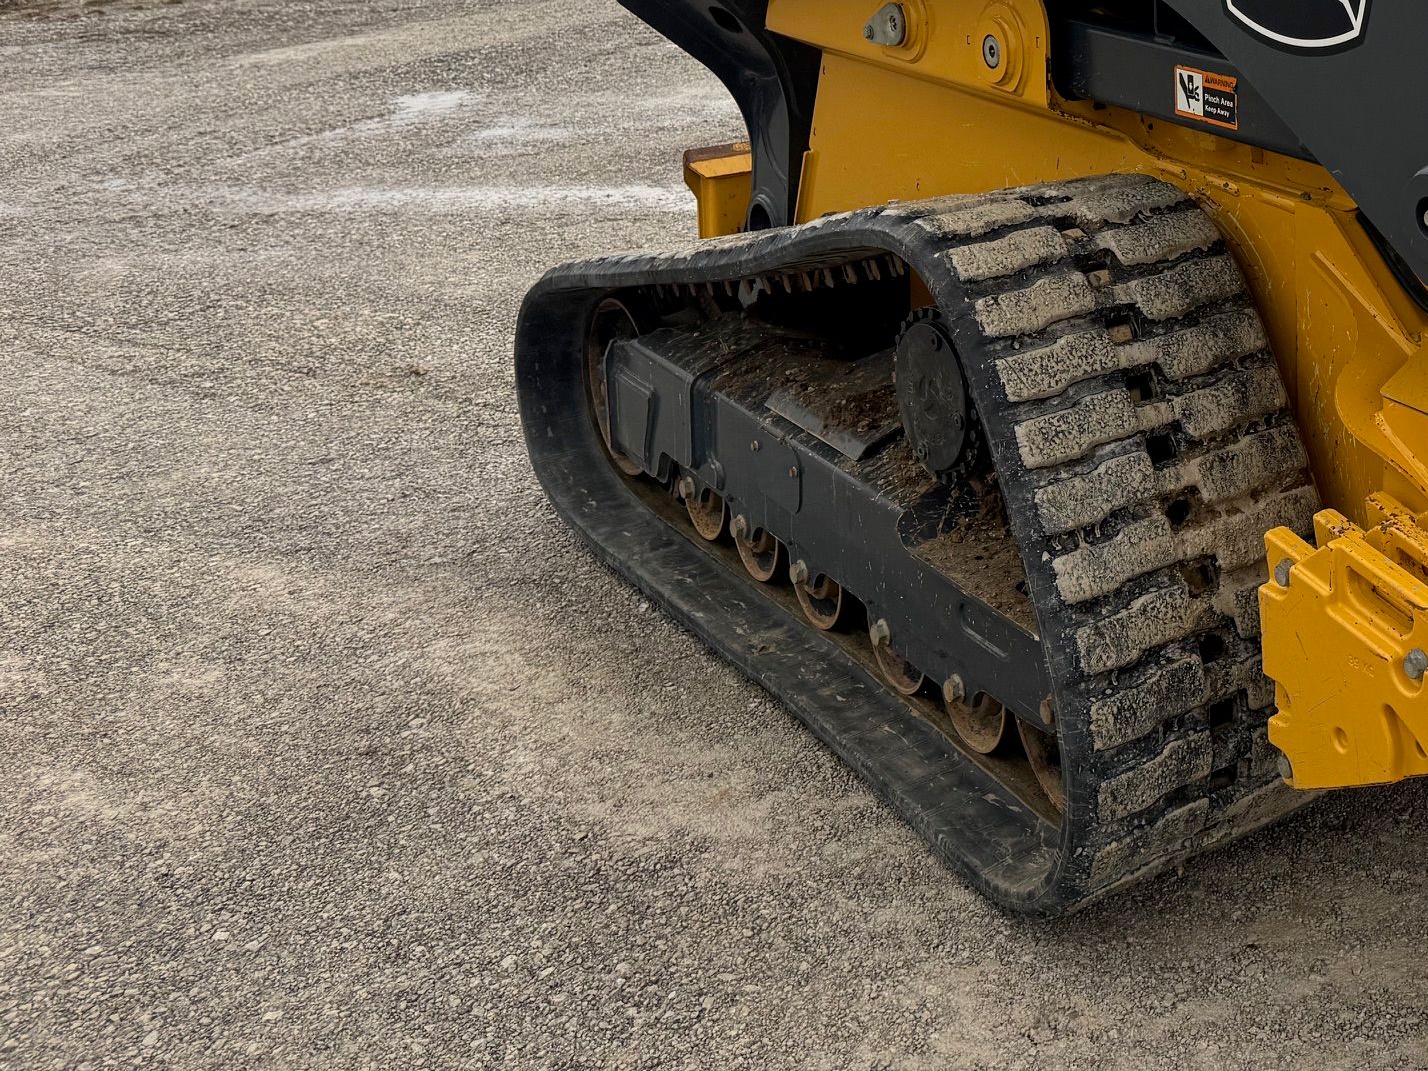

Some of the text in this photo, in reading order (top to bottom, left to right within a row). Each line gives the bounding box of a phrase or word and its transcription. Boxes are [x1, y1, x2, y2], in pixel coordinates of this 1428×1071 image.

[1209, 77, 1234, 89] WARNING
[1204, 93, 1234, 108] Pinch Area
[1204, 105, 1230, 118] Keep Away
